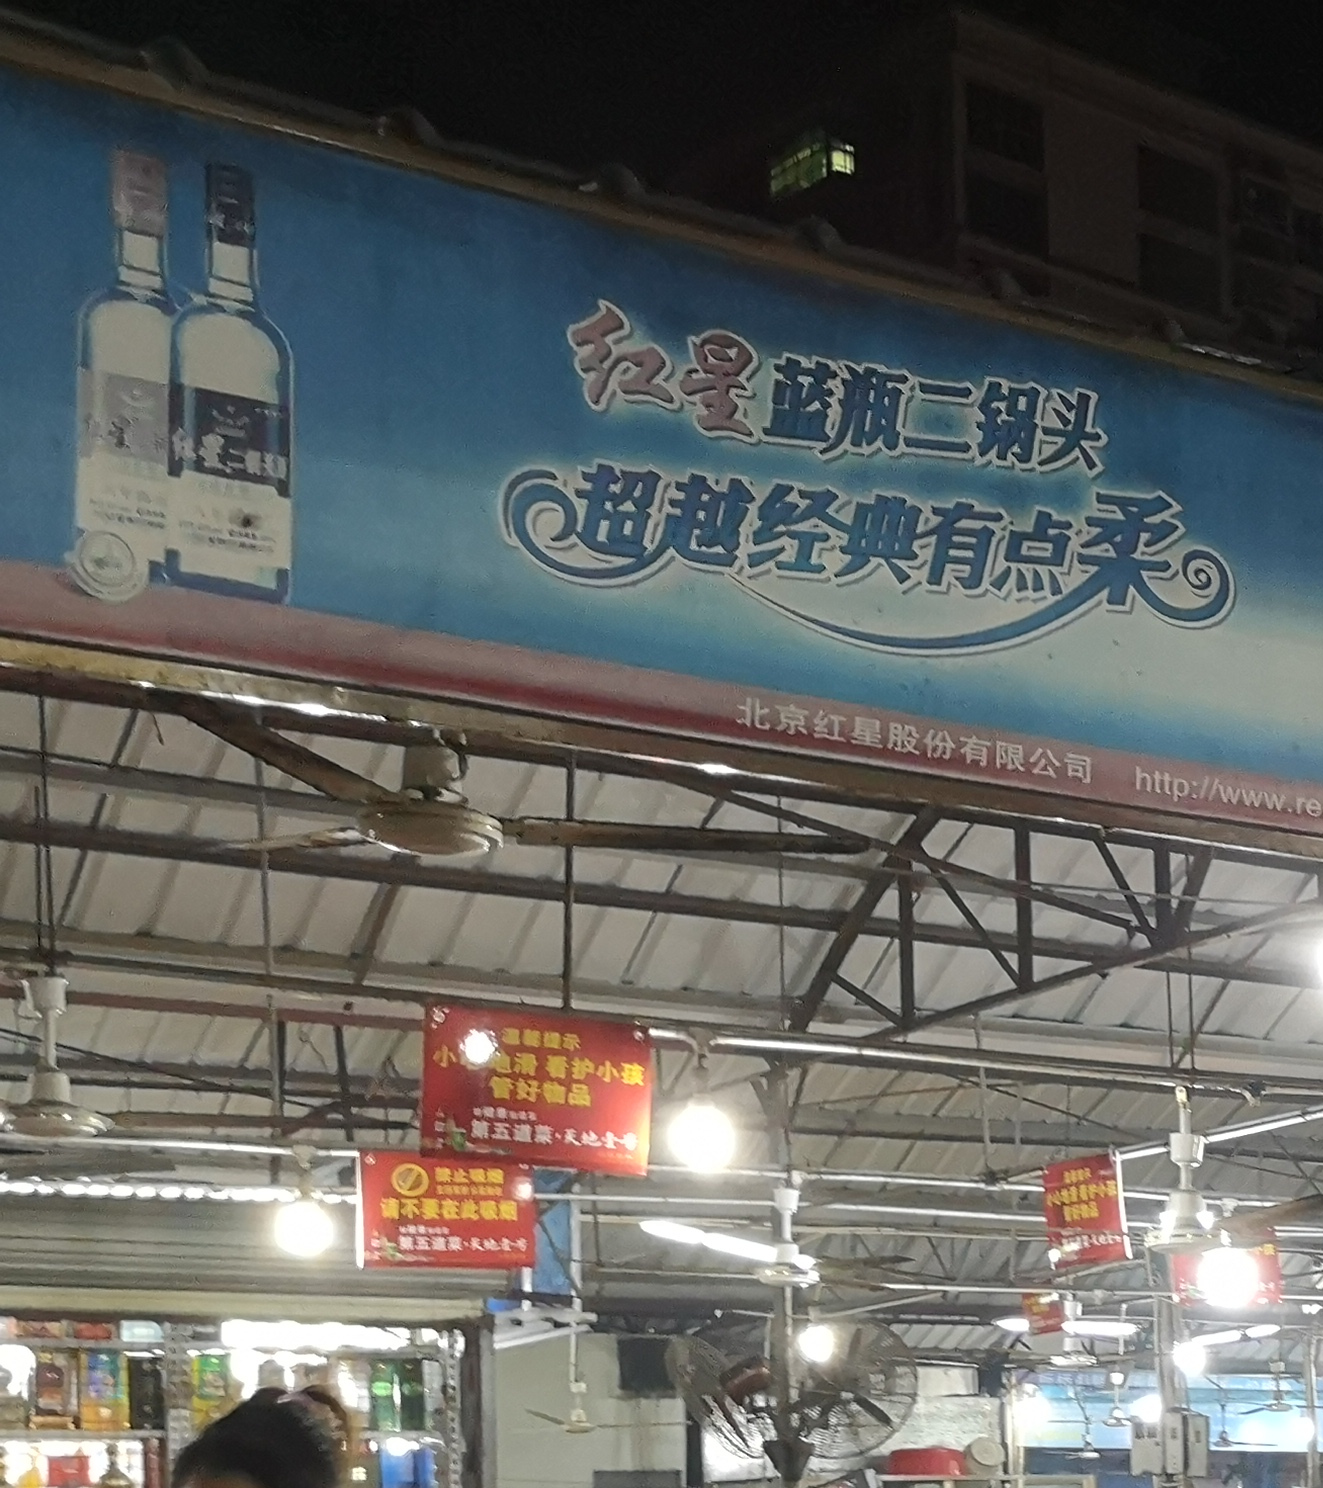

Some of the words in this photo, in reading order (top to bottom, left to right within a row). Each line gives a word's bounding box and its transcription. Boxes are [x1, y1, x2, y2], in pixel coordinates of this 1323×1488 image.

[568, 299, 1106, 473] 红星蓝瓶二锅头
[570, 459, 1184, 611] 超越经典有点柔
[735, 696, 1093, 786] 北京红星股份有限公司
